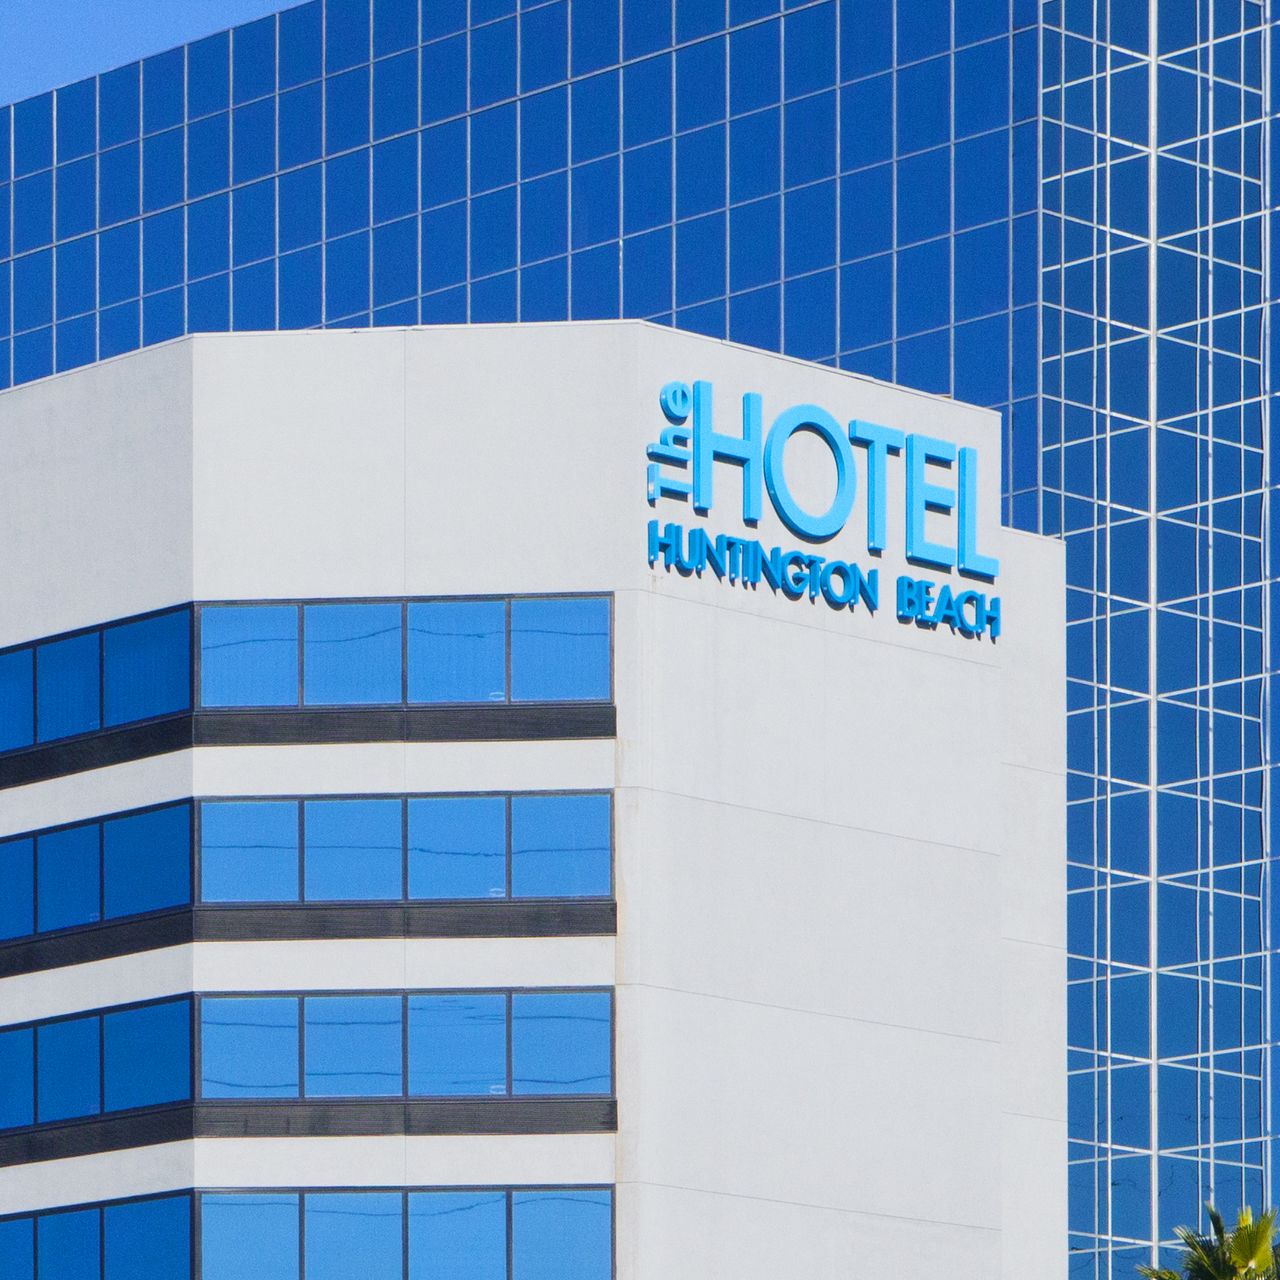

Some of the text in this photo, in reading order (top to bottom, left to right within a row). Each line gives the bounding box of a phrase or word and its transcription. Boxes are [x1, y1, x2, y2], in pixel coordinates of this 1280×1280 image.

[646, 381, 692, 502] The
[692, 379, 1001, 579] HOTEL
[647, 519, 1002, 640] HUNTINGTON BEACH
